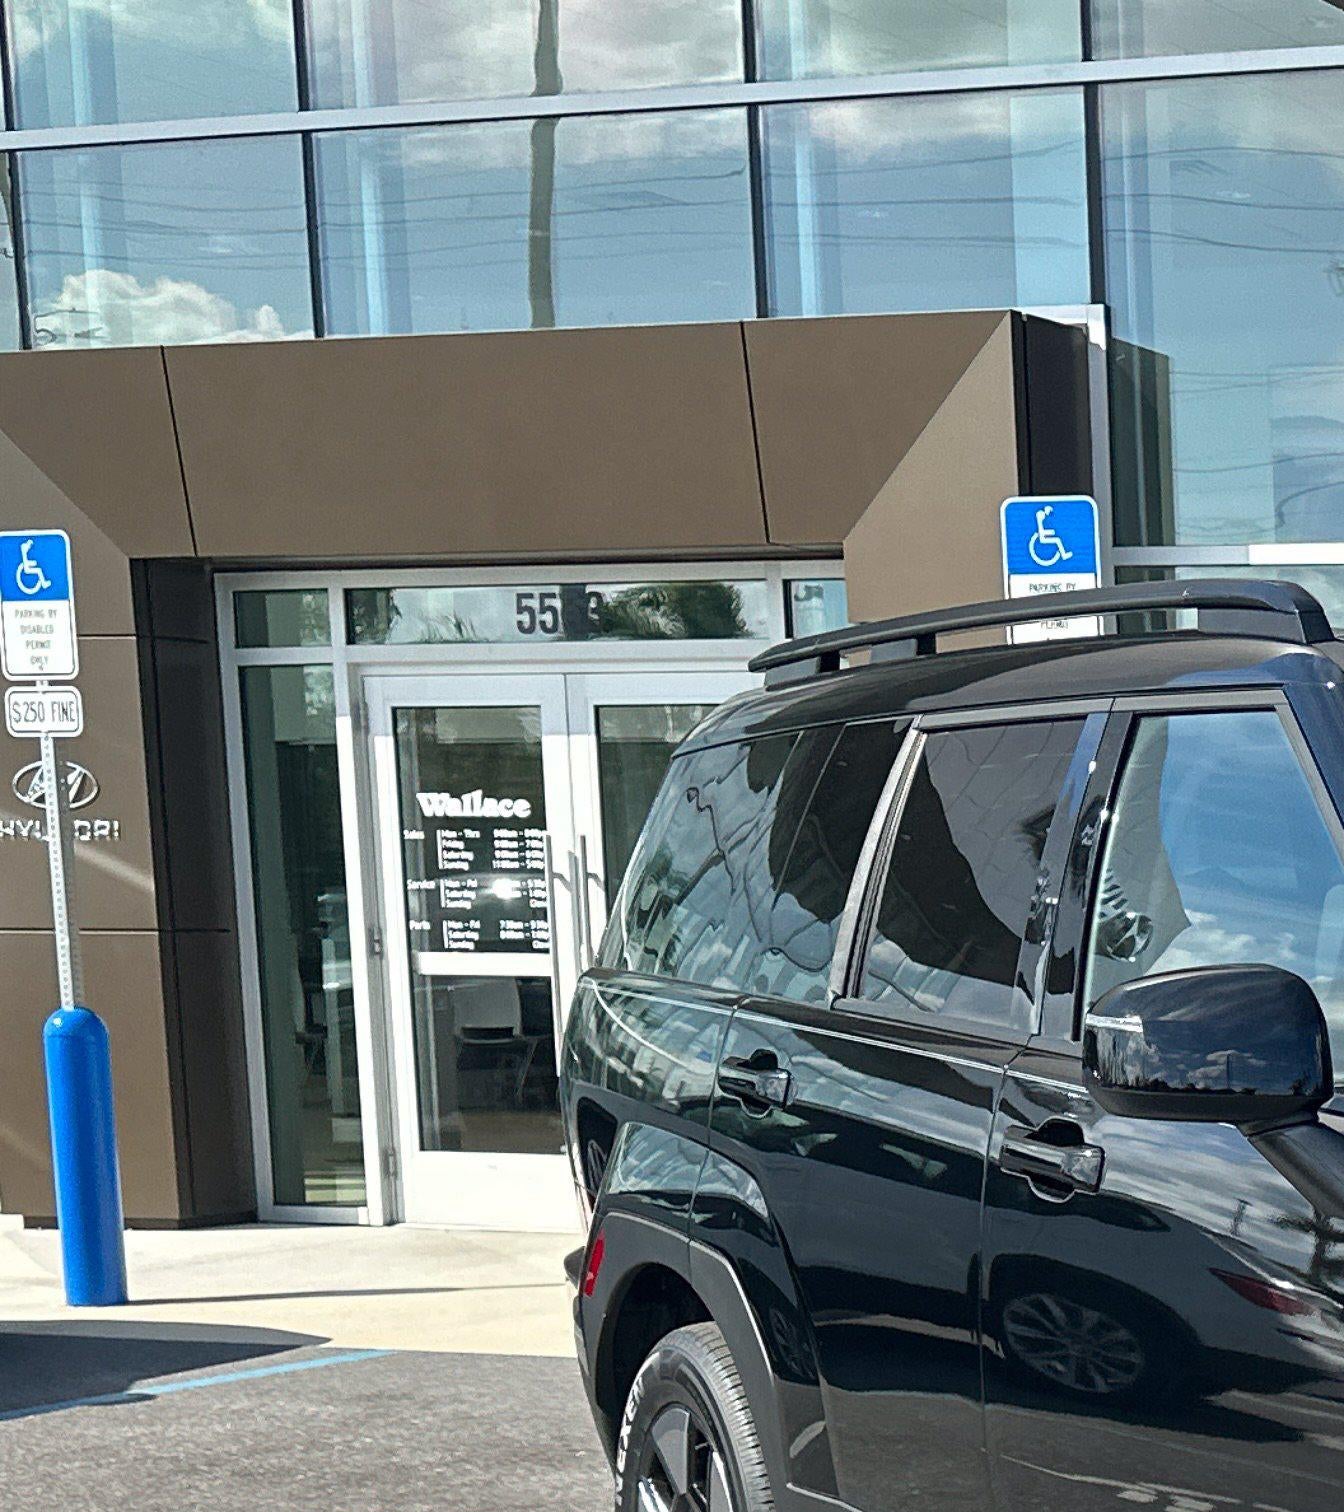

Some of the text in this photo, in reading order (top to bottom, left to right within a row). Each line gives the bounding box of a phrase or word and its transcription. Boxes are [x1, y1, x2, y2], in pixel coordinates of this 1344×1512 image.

[12, 700, 76, 724] $250 FINE
[416, 789, 532, 818] Wallace
[0, 819, 119, 841] HYUDAI
